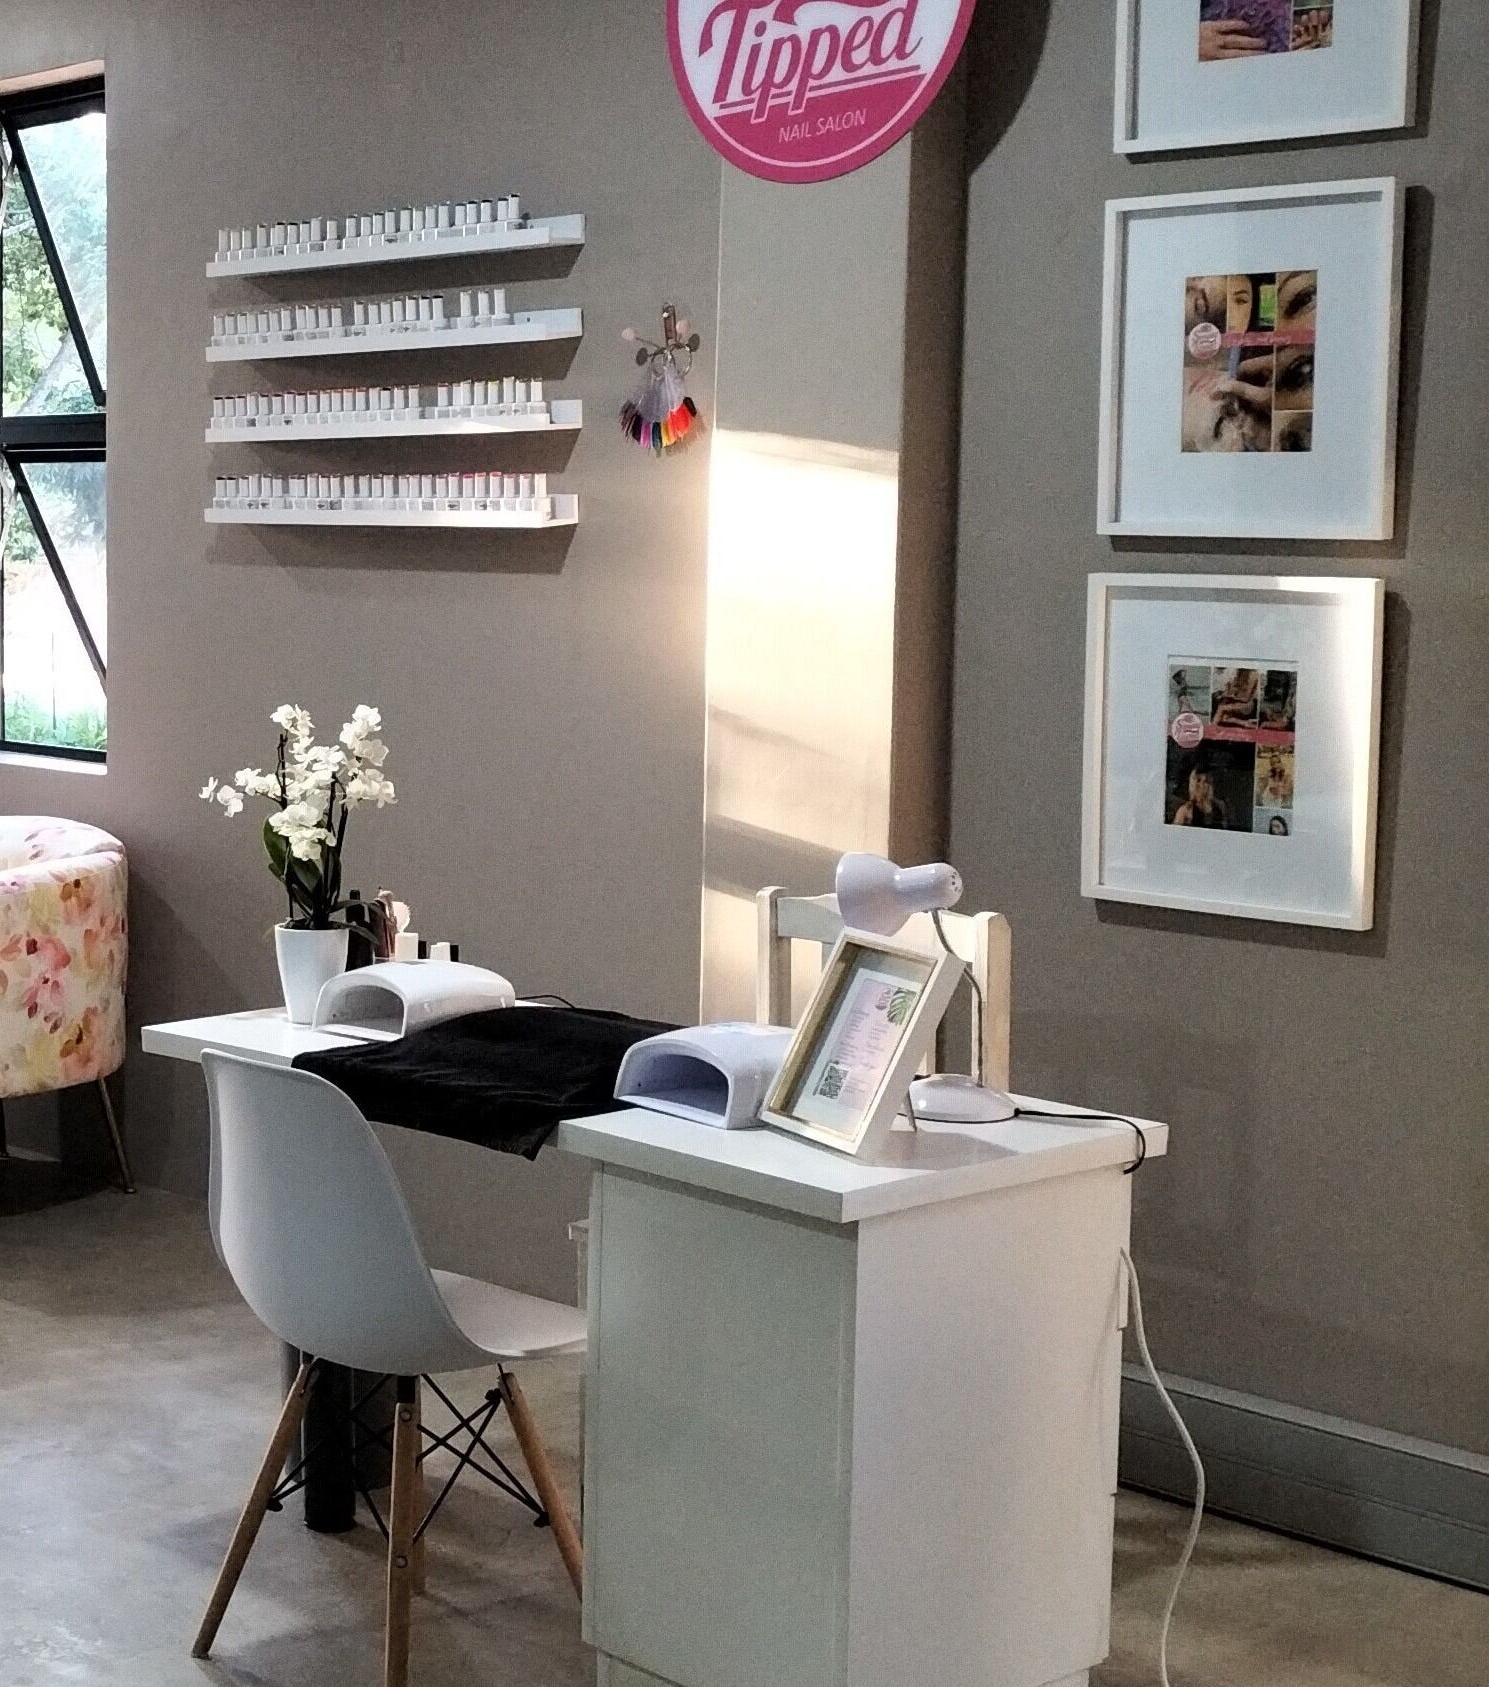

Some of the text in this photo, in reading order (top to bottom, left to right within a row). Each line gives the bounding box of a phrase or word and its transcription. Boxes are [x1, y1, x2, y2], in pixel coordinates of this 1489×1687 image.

[698, 0, 923, 124] Tipped
[778, 108, 867, 143] NAIL SALON
